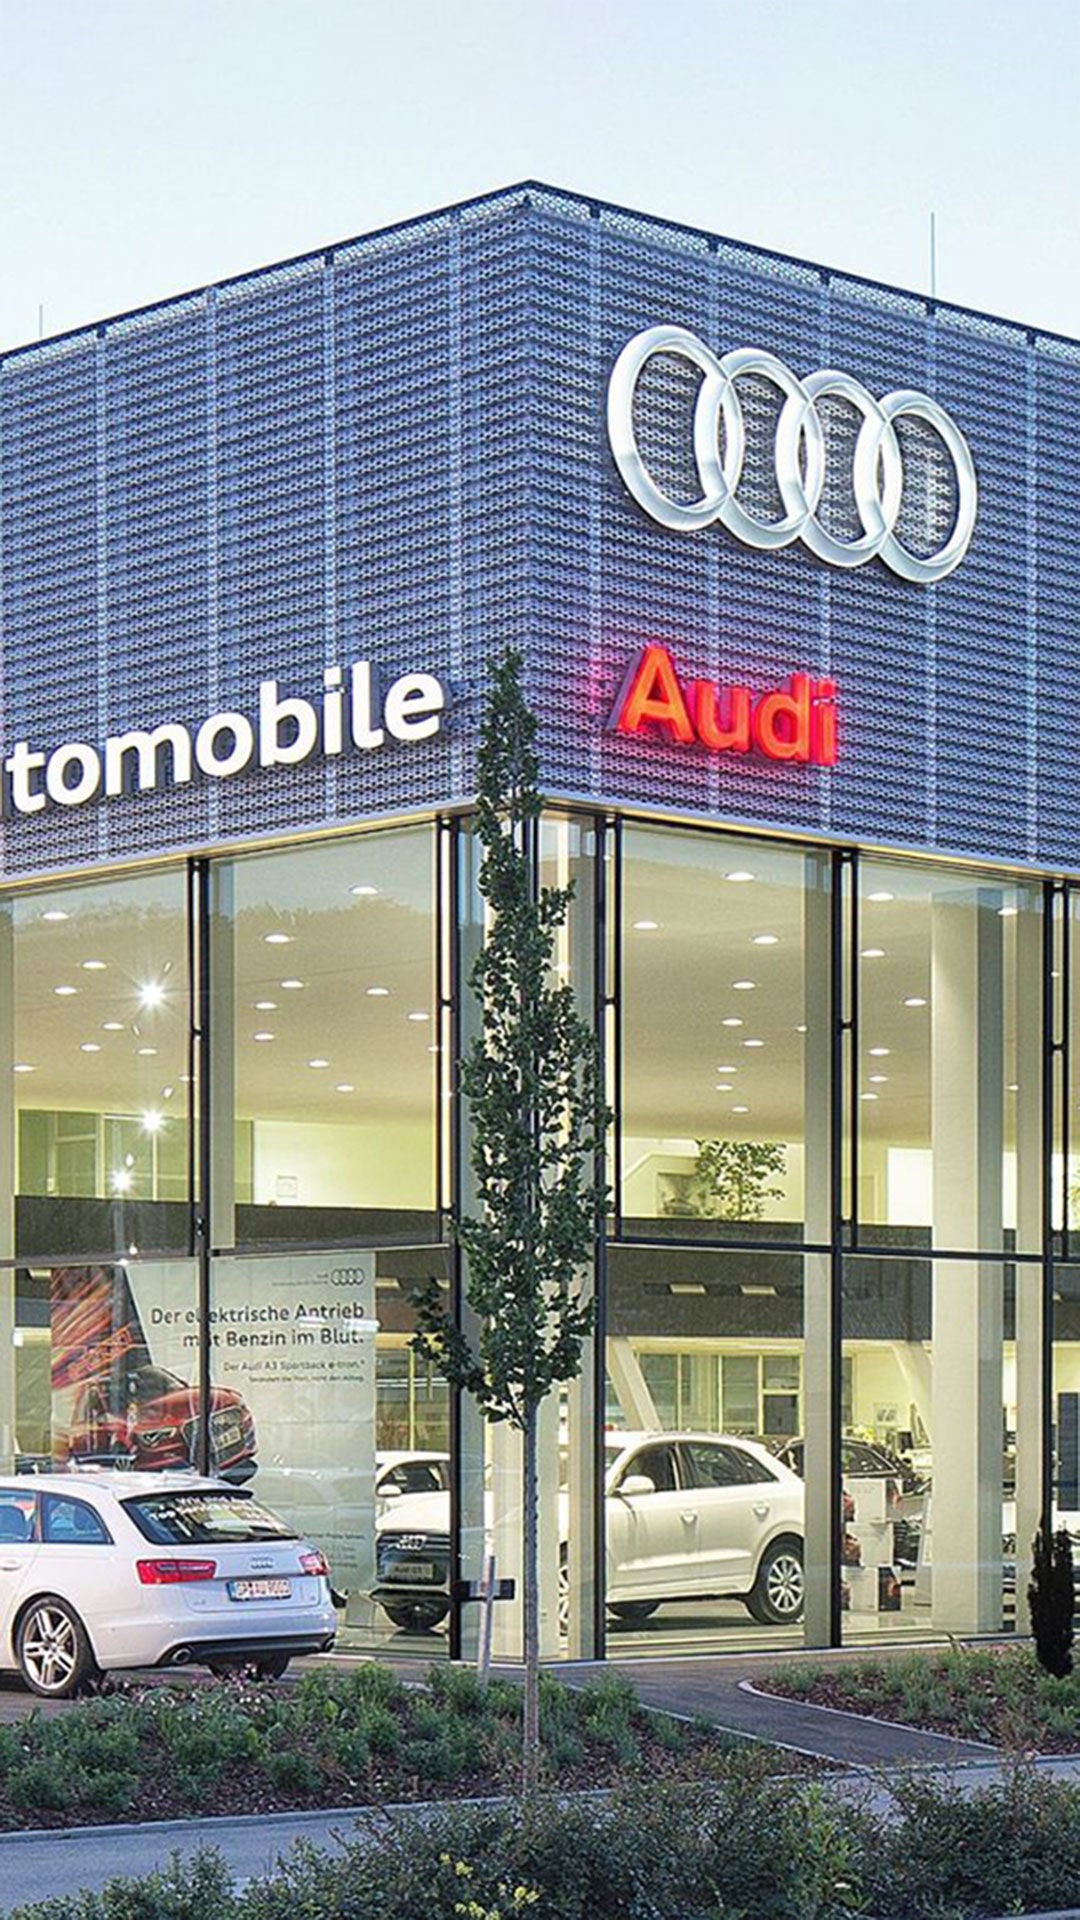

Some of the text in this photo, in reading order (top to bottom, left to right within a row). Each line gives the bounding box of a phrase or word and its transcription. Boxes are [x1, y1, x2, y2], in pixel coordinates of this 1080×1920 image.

[0, 661, 445, 813] tomobile
[613, 643, 838, 766] Audi
[151, 1307, 181, 1324] Der
[294, 1301, 364, 1320] Antrieb
[183, 1327, 364, 1347] mt Benzin im Blut.
